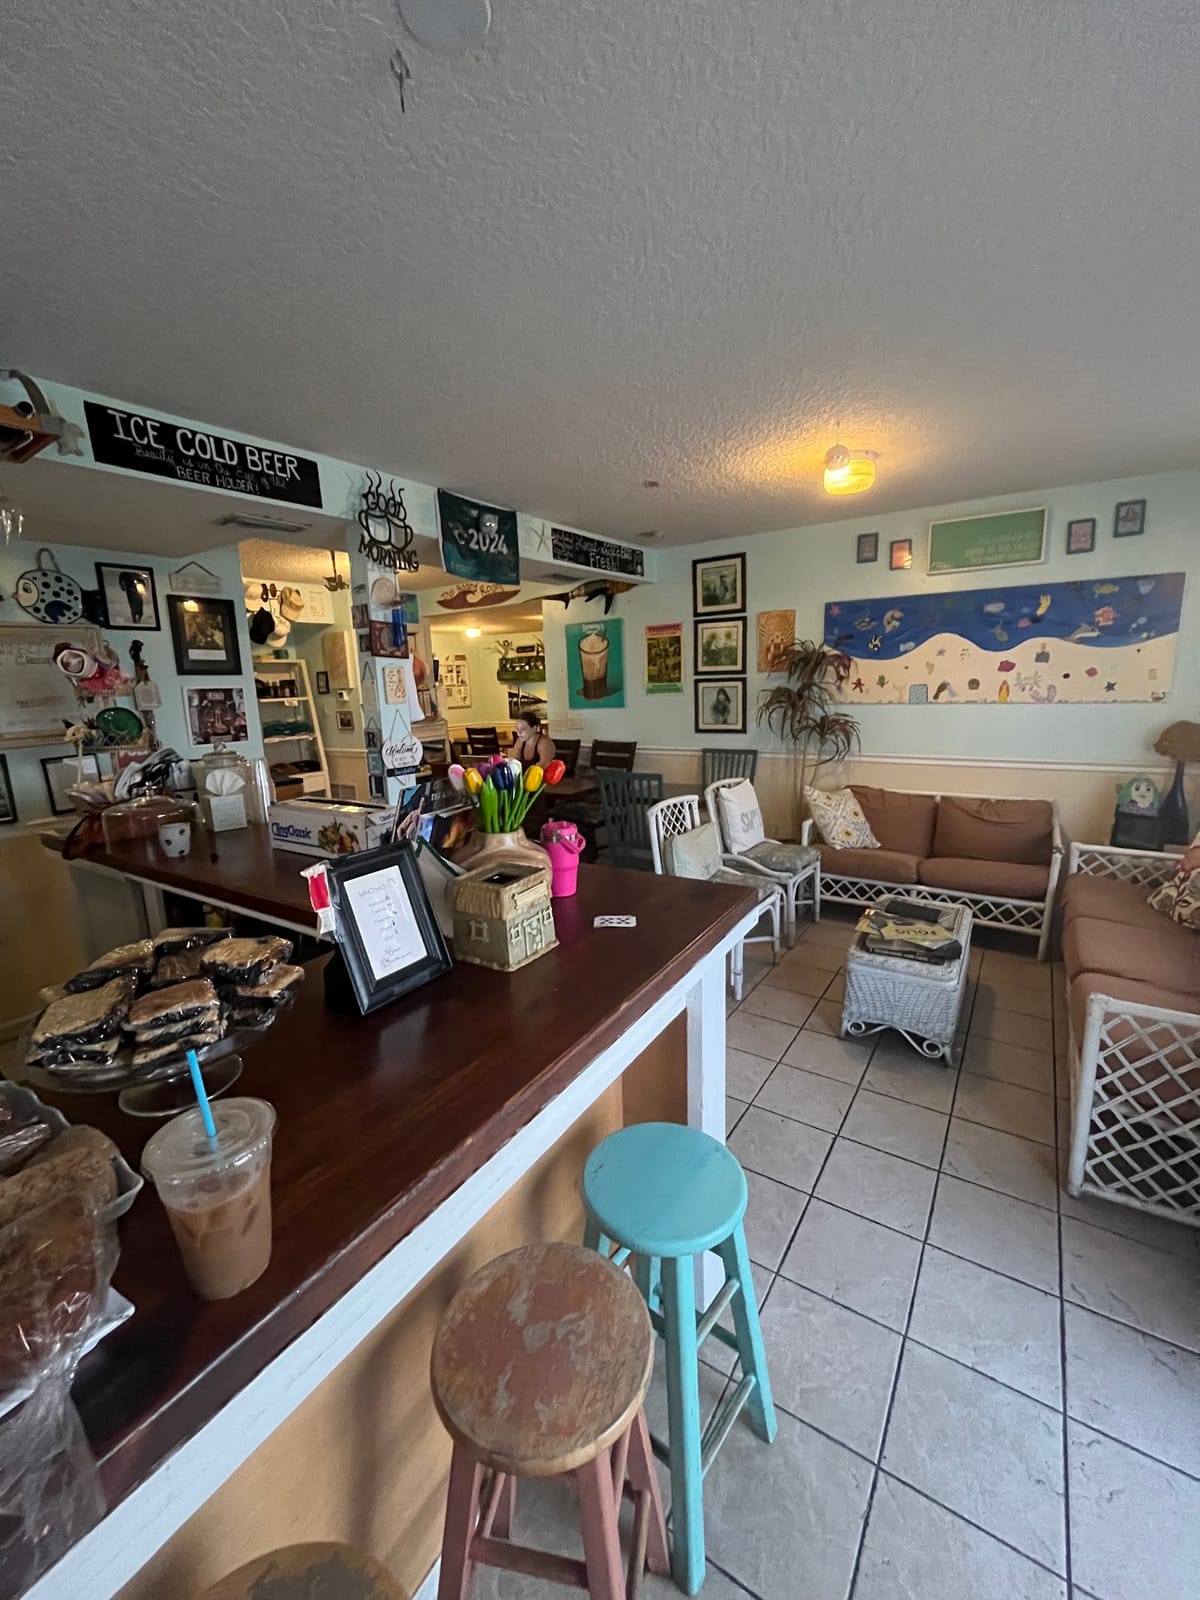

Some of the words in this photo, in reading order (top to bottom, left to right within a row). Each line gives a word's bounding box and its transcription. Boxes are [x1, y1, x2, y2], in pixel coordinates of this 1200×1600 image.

[107, 409, 165, 450] ICE
[176, 428, 238, 466] COLD
[245, 446, 301, 481] BEER
[176, 465, 211, 485] BEER
[216, 472, 261, 495] HOLDER!
[358, 532, 419, 573] MORNING
[467, 527, 509, 556] 2024
